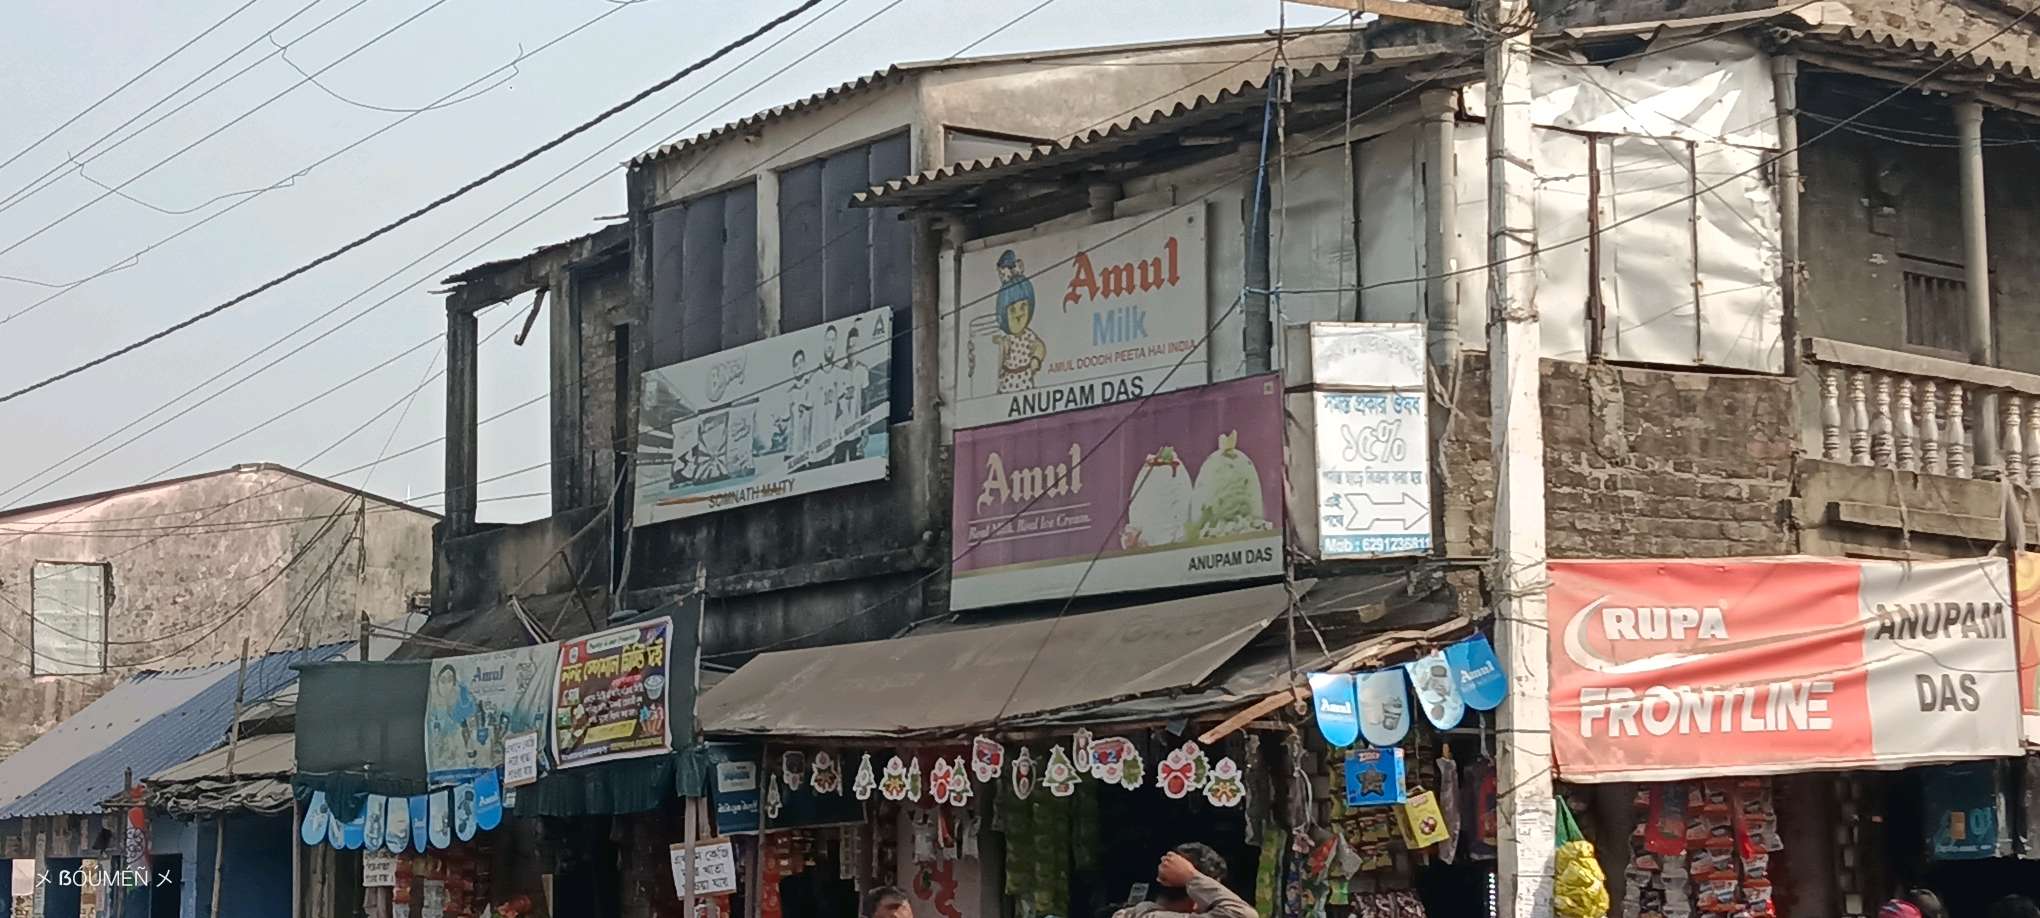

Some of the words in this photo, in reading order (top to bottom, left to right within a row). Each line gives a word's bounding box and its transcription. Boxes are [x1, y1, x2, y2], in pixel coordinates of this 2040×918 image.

[1063, 236, 1180, 313] Amul
[1092, 304, 1148, 347] Milk
[1047, 359, 1074, 374] AMUL
[1076, 352, 1113, 369] DOODH
[1114, 347, 1146, 363] PEETA
[1148, 344, 1166, 357] HAI
[1167, 339, 1196, 354] INDIA
[1007, 382, 1095, 418] ANUPAM
[1101, 375, 1144, 404] DAS
[977, 443, 1083, 514] Amul
[967, 525, 990, 540] Real
[1016, 517, 1039, 533] Real
[1040, 515, 1055, 529] Ice
[1188, 549, 1243, 572] ANUPAM
[1245, 546, 1273, 565] DAS
[1601, 607, 1729, 640] RUPA
[1873, 601, 2007, 640] ANUPAM
[472, 665, 504, 682] Amul
[1459, 660, 1495, 684] Amul
[1320, 698, 1352, 714] Amul
[1578, 681, 1835, 739] FRONTLINE
[1915, 673, 1981, 712] DAS
